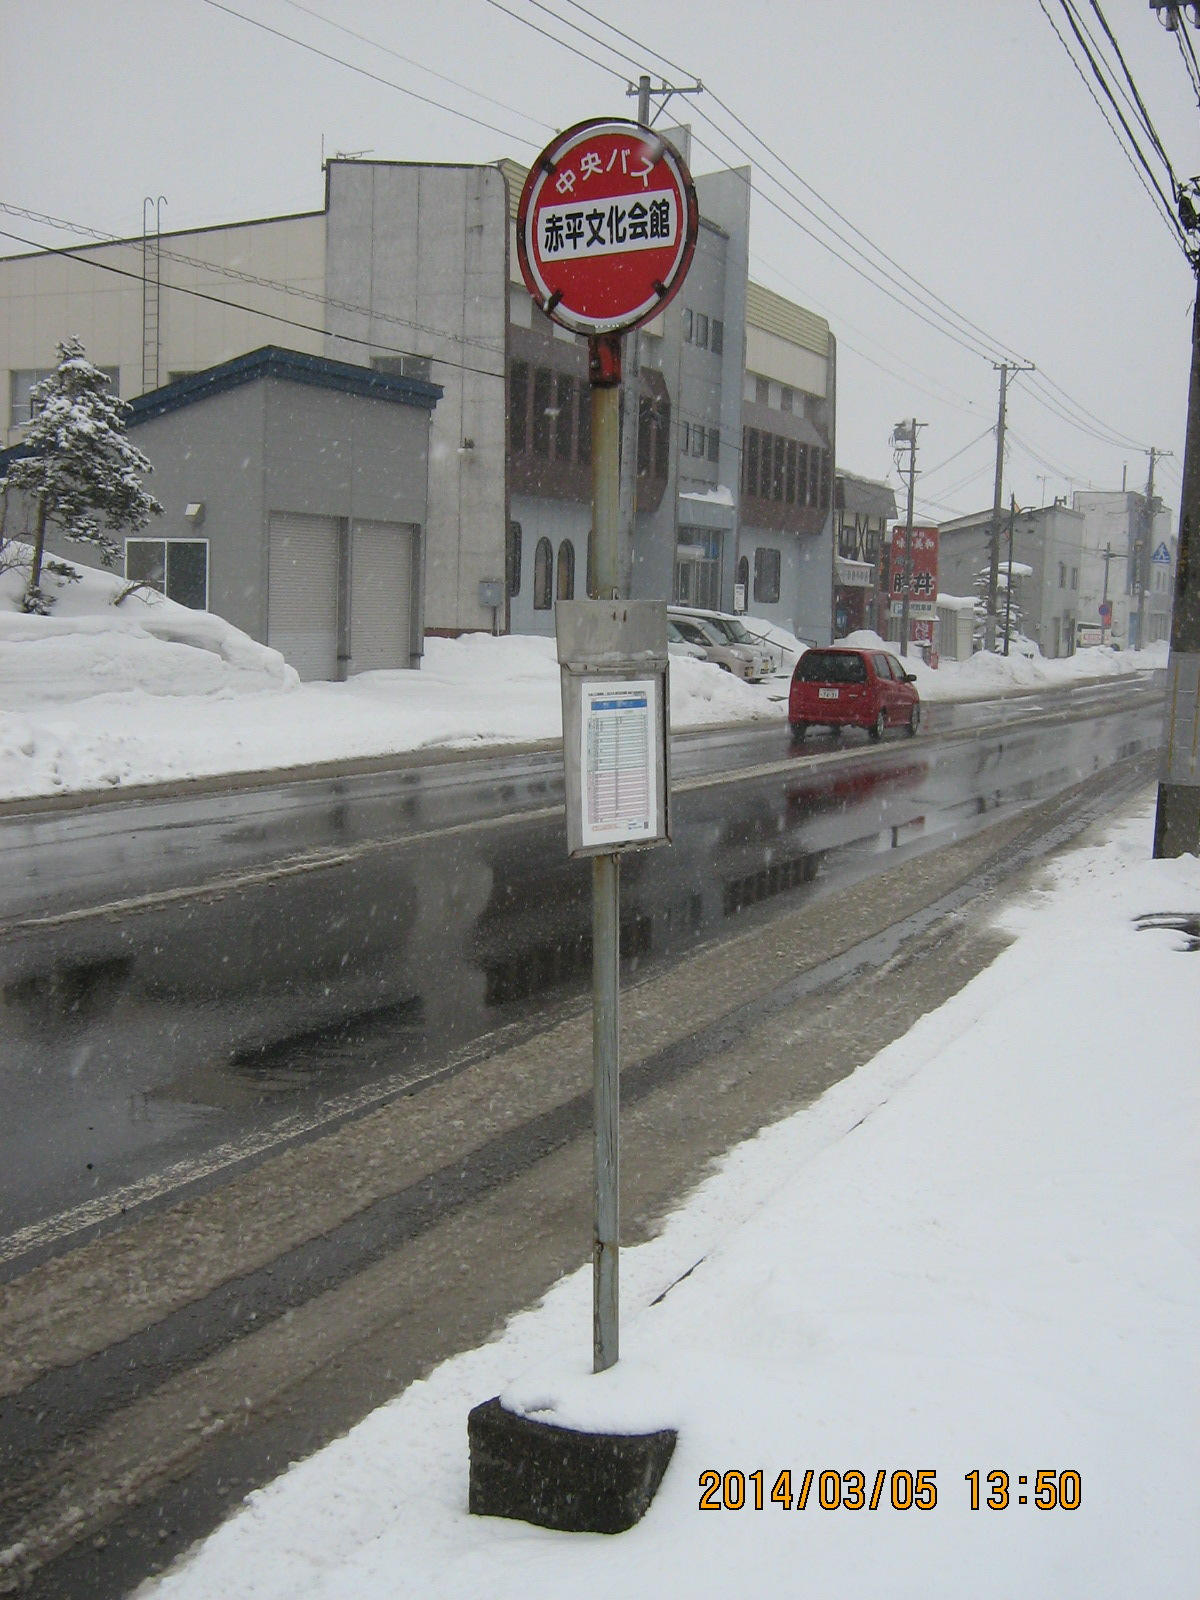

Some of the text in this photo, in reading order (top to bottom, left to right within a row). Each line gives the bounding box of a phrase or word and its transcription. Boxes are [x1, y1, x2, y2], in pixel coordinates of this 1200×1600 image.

[555, 148, 655, 195] 中央バス
[544, 198, 671, 253] 赤平文化会館
[896, 537, 935, 550] 味美和
